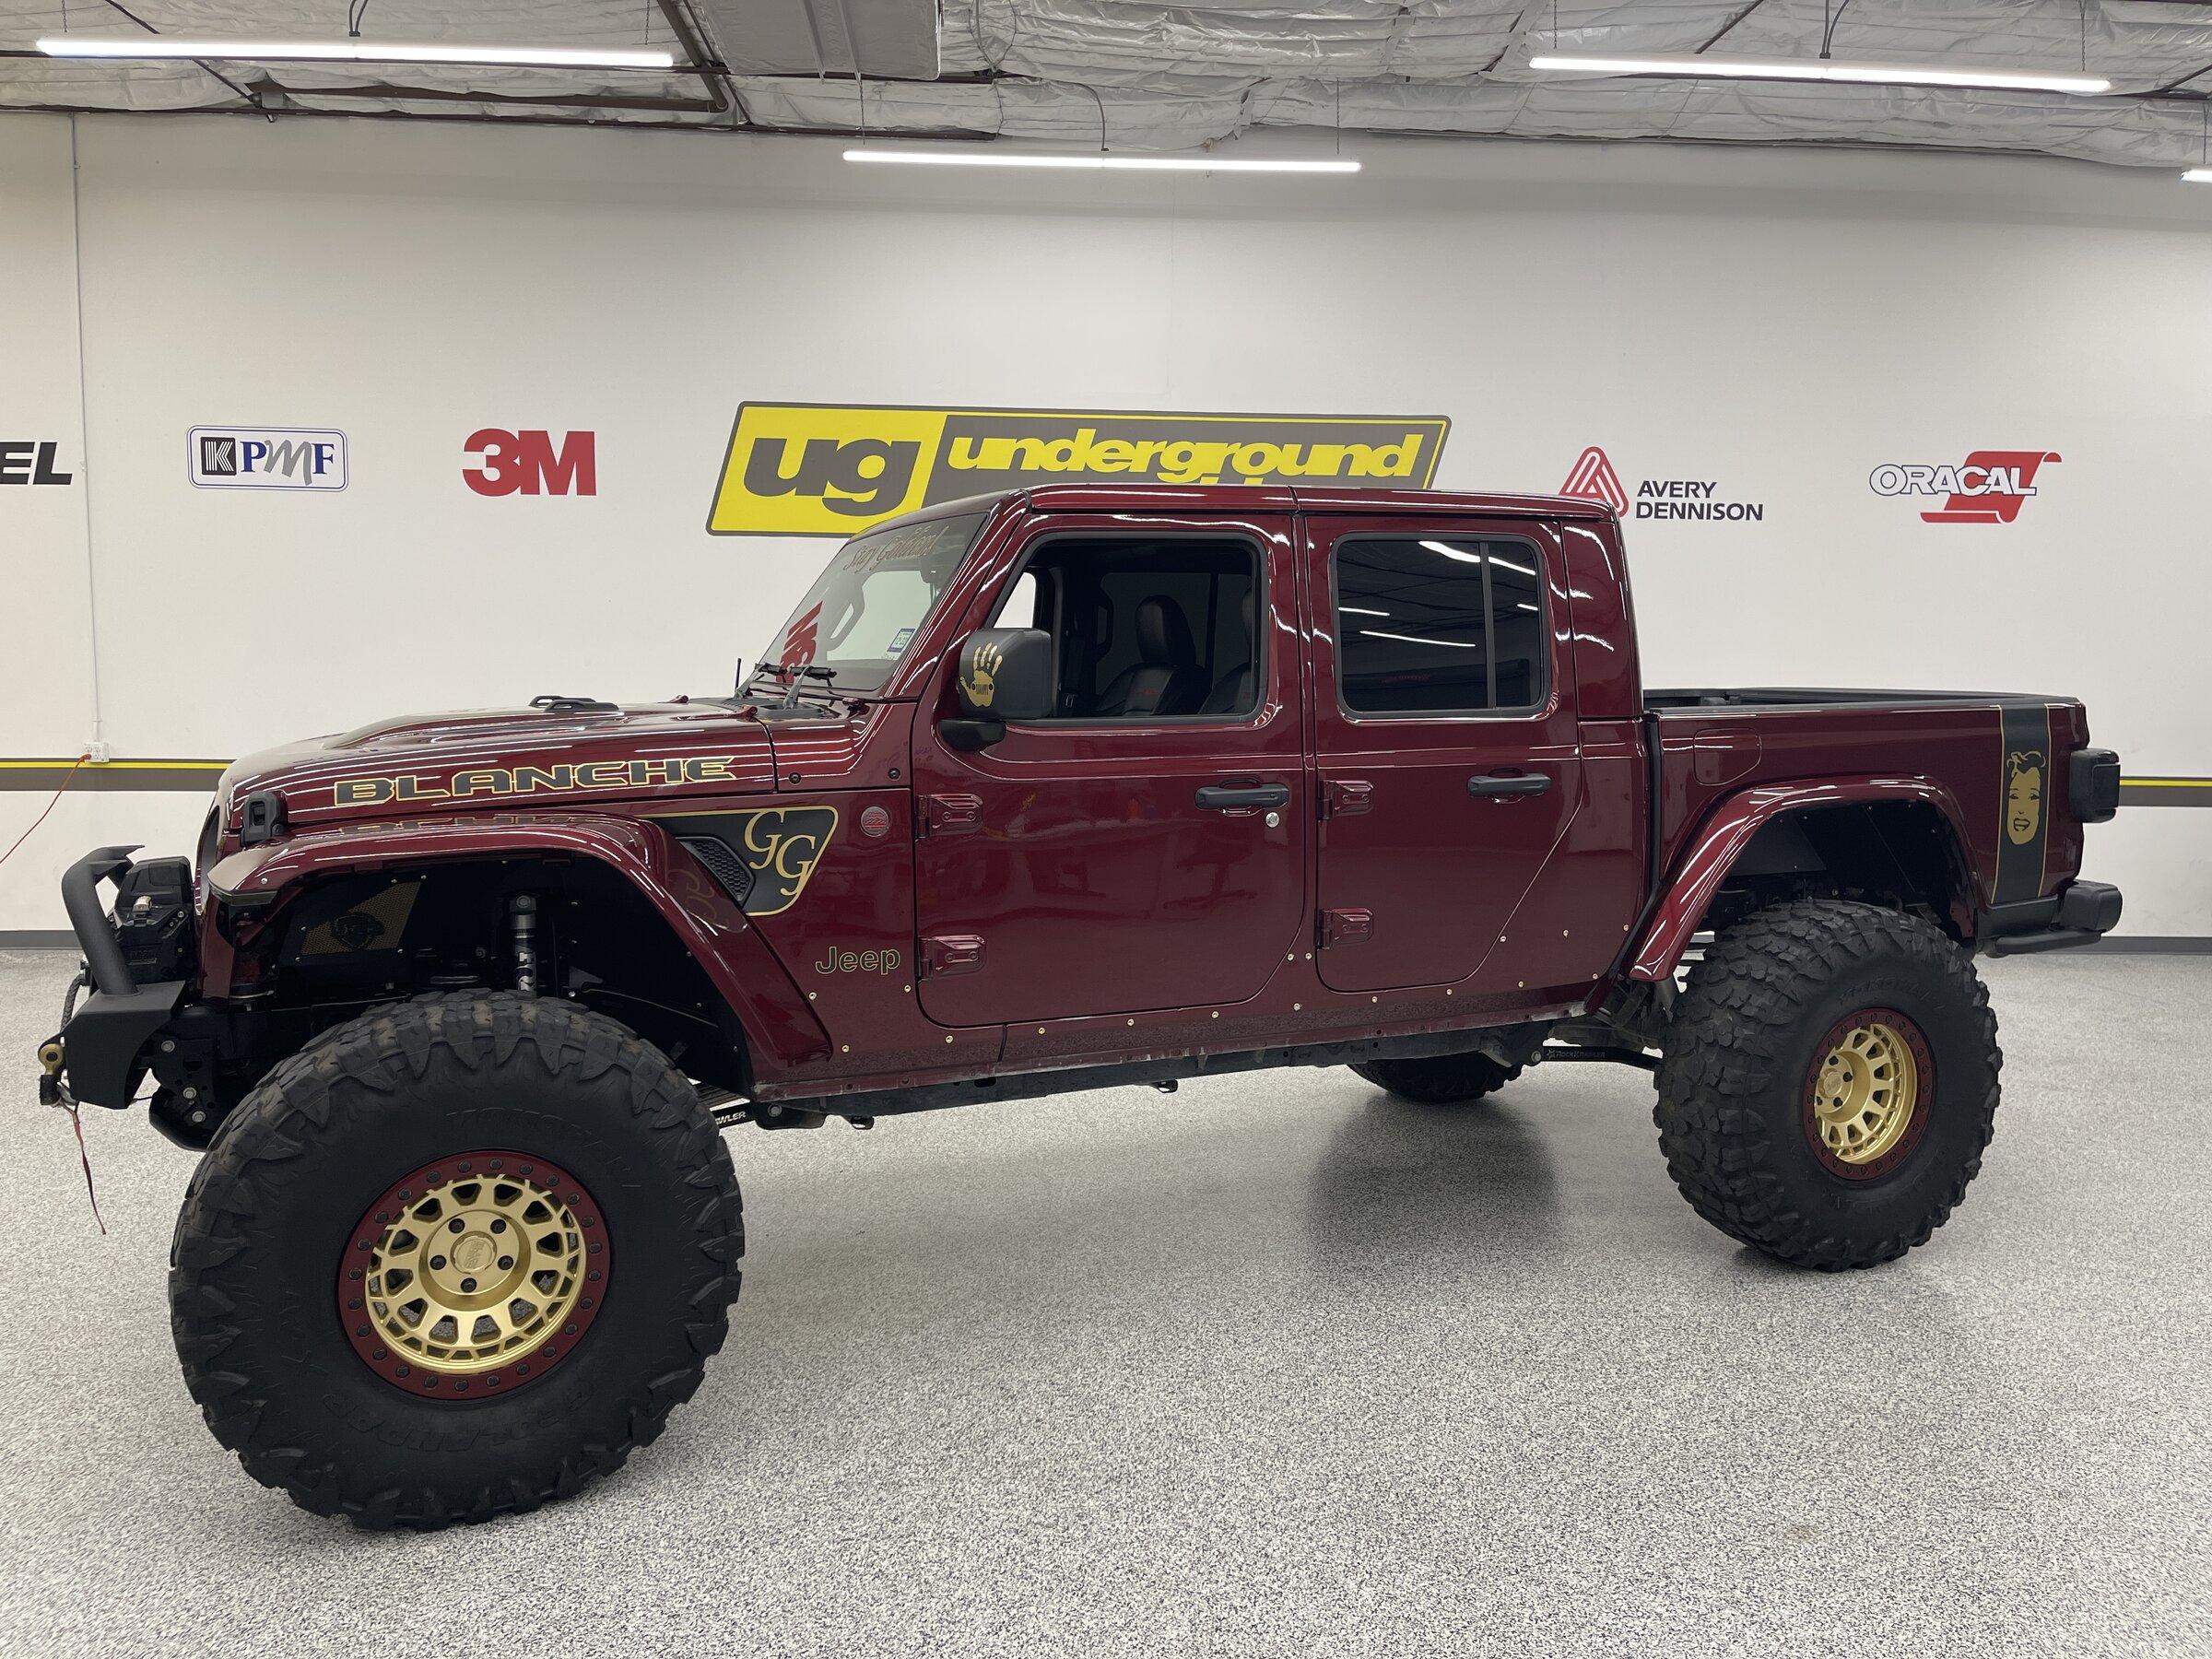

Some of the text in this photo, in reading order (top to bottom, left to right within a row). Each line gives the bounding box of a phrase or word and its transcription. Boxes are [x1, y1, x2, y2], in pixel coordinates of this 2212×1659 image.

[462, 428, 597, 497] 3M
[742, 428, 1424, 518] ug underground
[1636, 479, 1717, 499] AVERY
[1868, 463, 2037, 497] ORACAL
[1635, 501, 1764, 522] DENNISON
[334, 756, 737, 806] BLANCHE
[815, 946, 901, 976] Jeep
